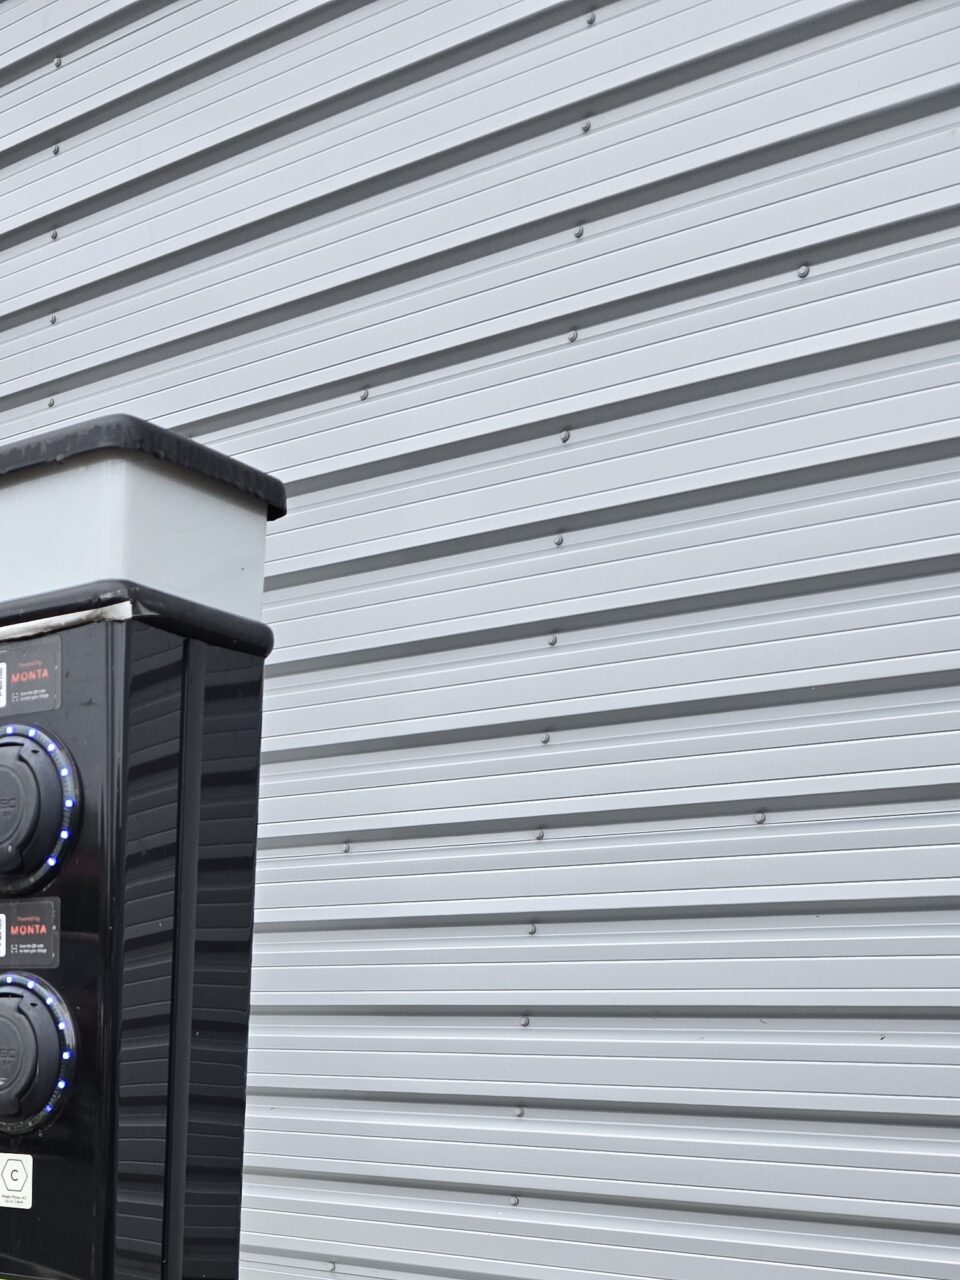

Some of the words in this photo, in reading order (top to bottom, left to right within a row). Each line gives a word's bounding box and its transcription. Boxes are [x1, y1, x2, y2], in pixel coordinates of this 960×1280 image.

[10, 668, 49, 684] MONTA
[10, 924, 47, 935] MONTA
[10, 1169, 19, 1181] C
